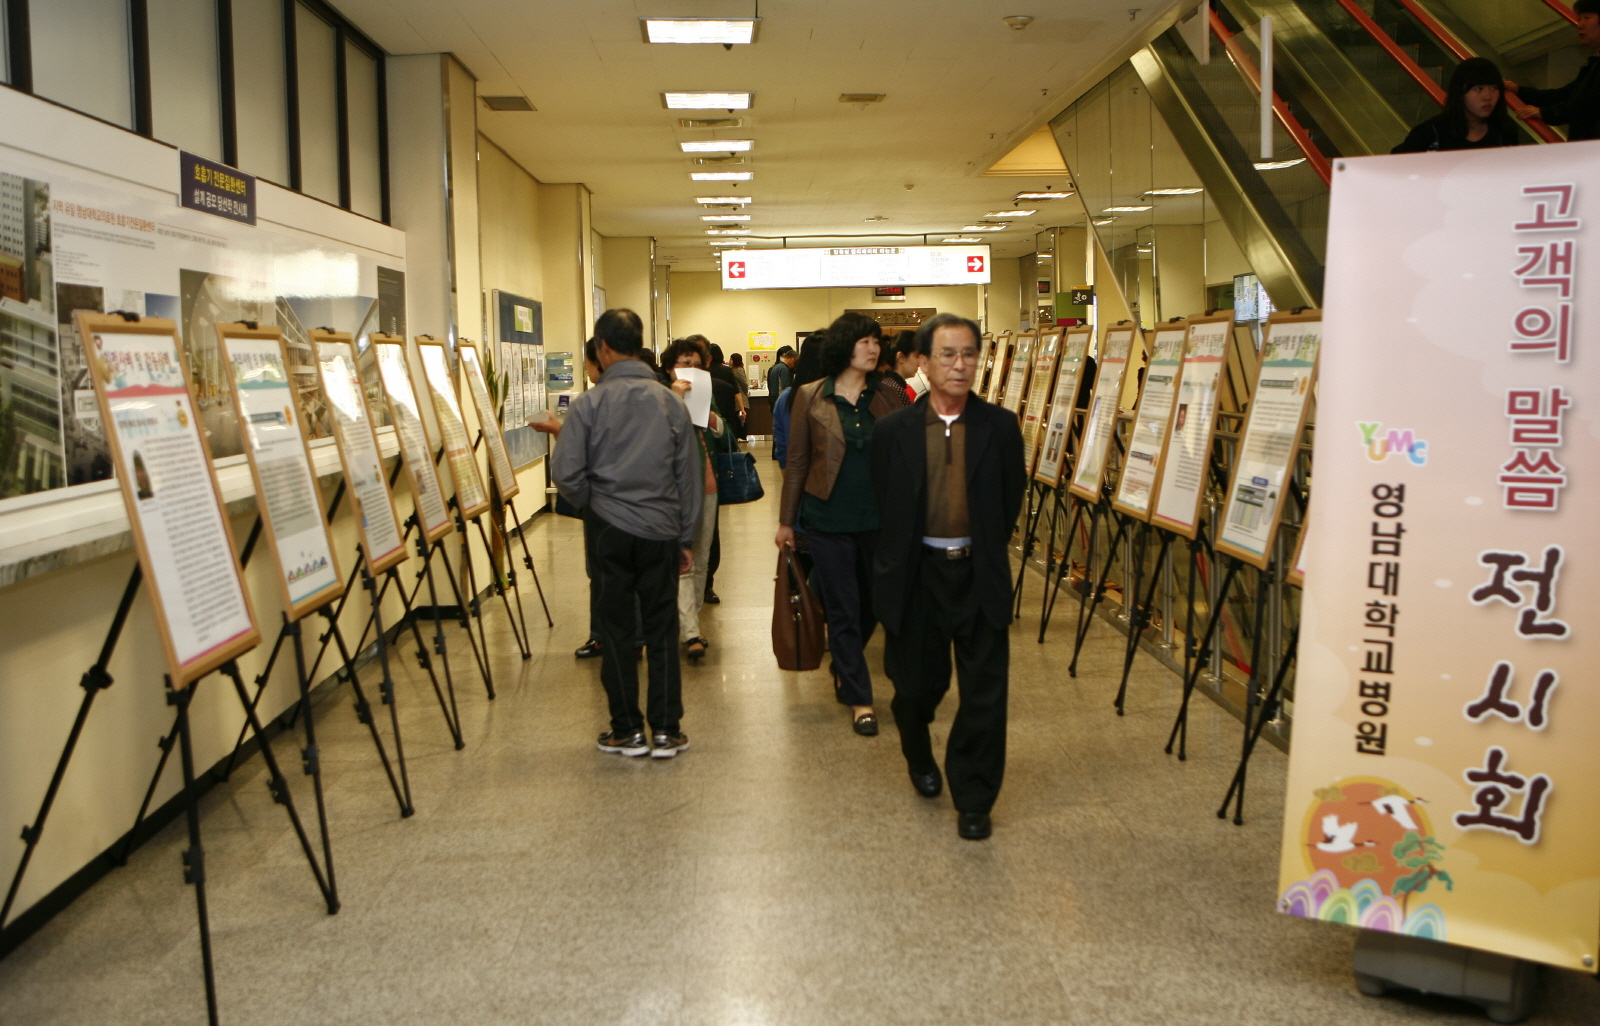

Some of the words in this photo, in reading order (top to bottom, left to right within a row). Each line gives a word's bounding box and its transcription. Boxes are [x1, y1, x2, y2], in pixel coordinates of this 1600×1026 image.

[77, 204, 116, 226] 영남대학교의료원
[116, 213, 156, 233] 호흡기전문질환센터
[194, 164, 213, 186] 호흡기
[213, 170, 247, 196] 전문질환센터
[194, 188, 206, 206] 설계
[206, 191, 217, 208] 공모
[217, 195, 233, 213] 당선작
[233, 200, 248, 218] 전시회
[1509, 183, 1580, 362] 고객의
[1357, 422, 1428, 465] YUMC
[1499, 387, 1571, 509] 말씀
[1355, 483, 1407, 757] 영남대학교병원
[1455, 546, 1568, 842] 전시회
